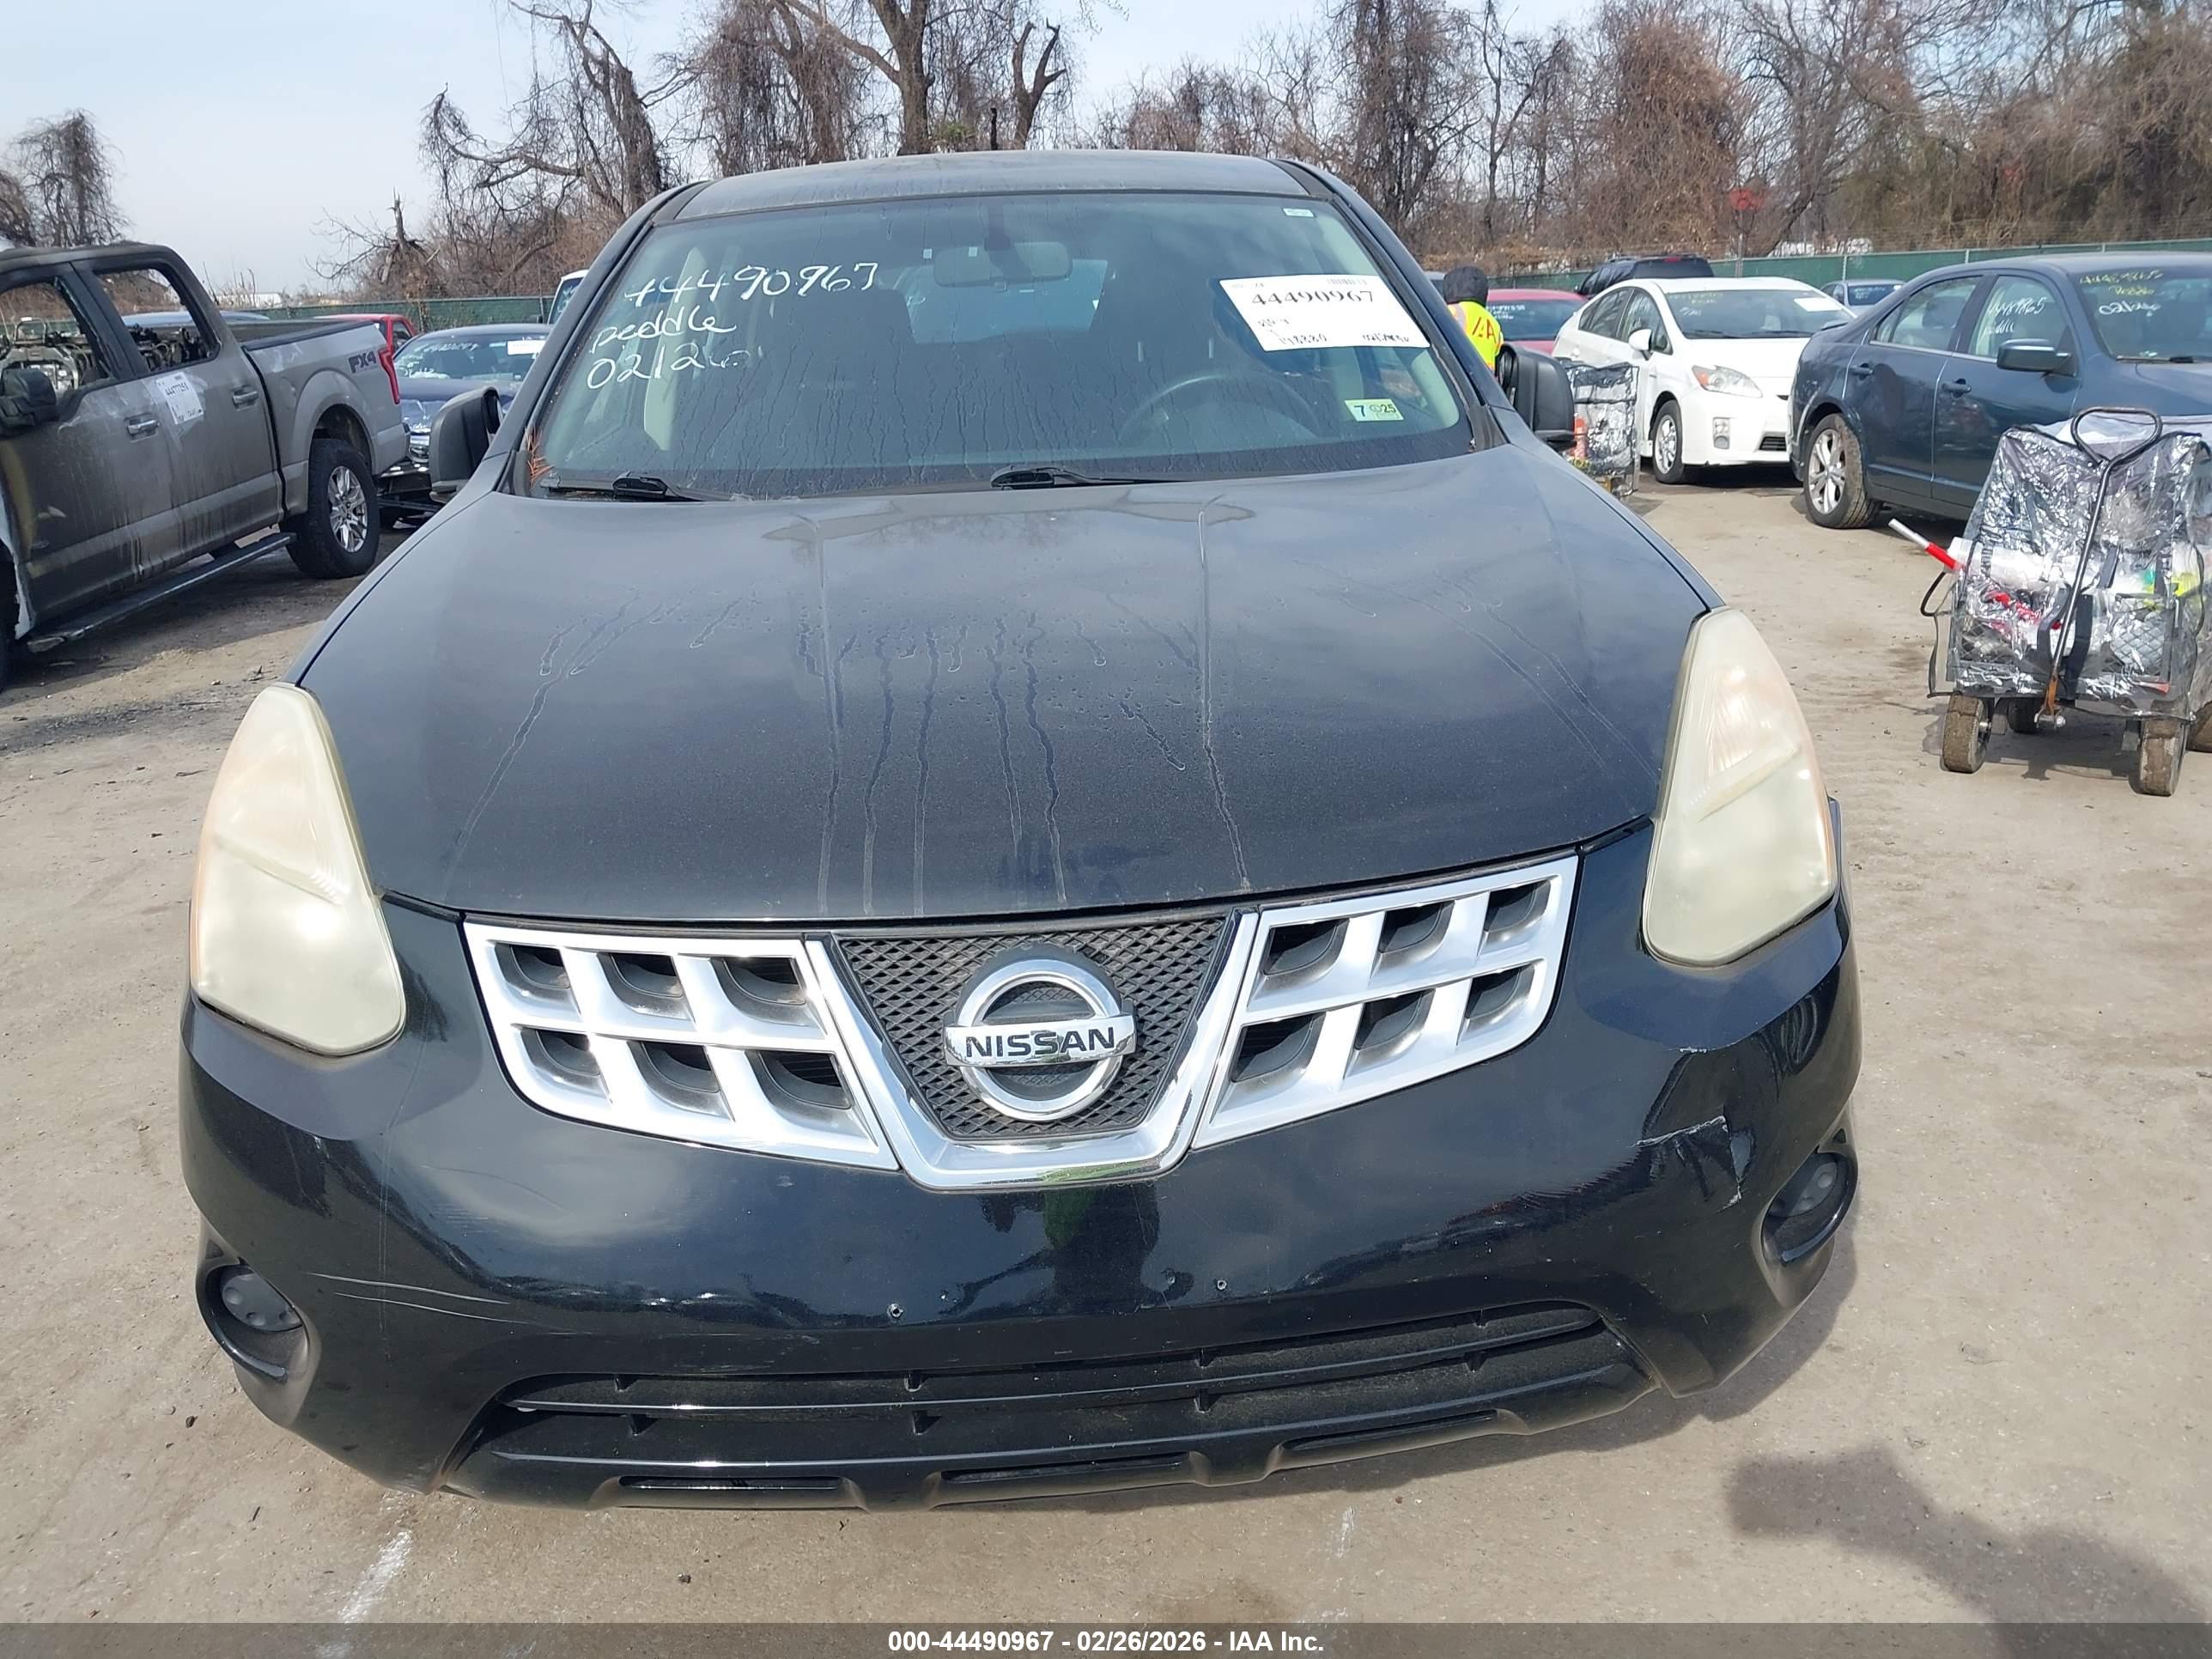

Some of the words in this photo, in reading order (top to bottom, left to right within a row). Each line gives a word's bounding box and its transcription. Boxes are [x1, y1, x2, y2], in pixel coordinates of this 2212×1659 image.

[1251, 289, 1374, 305] 44490967
[348, 349, 378, 374] FX4
[1353, 404, 1365, 417] 7
[1380, 404, 1396, 413] 25
[965, 1026, 1115, 1058] NISSAN
